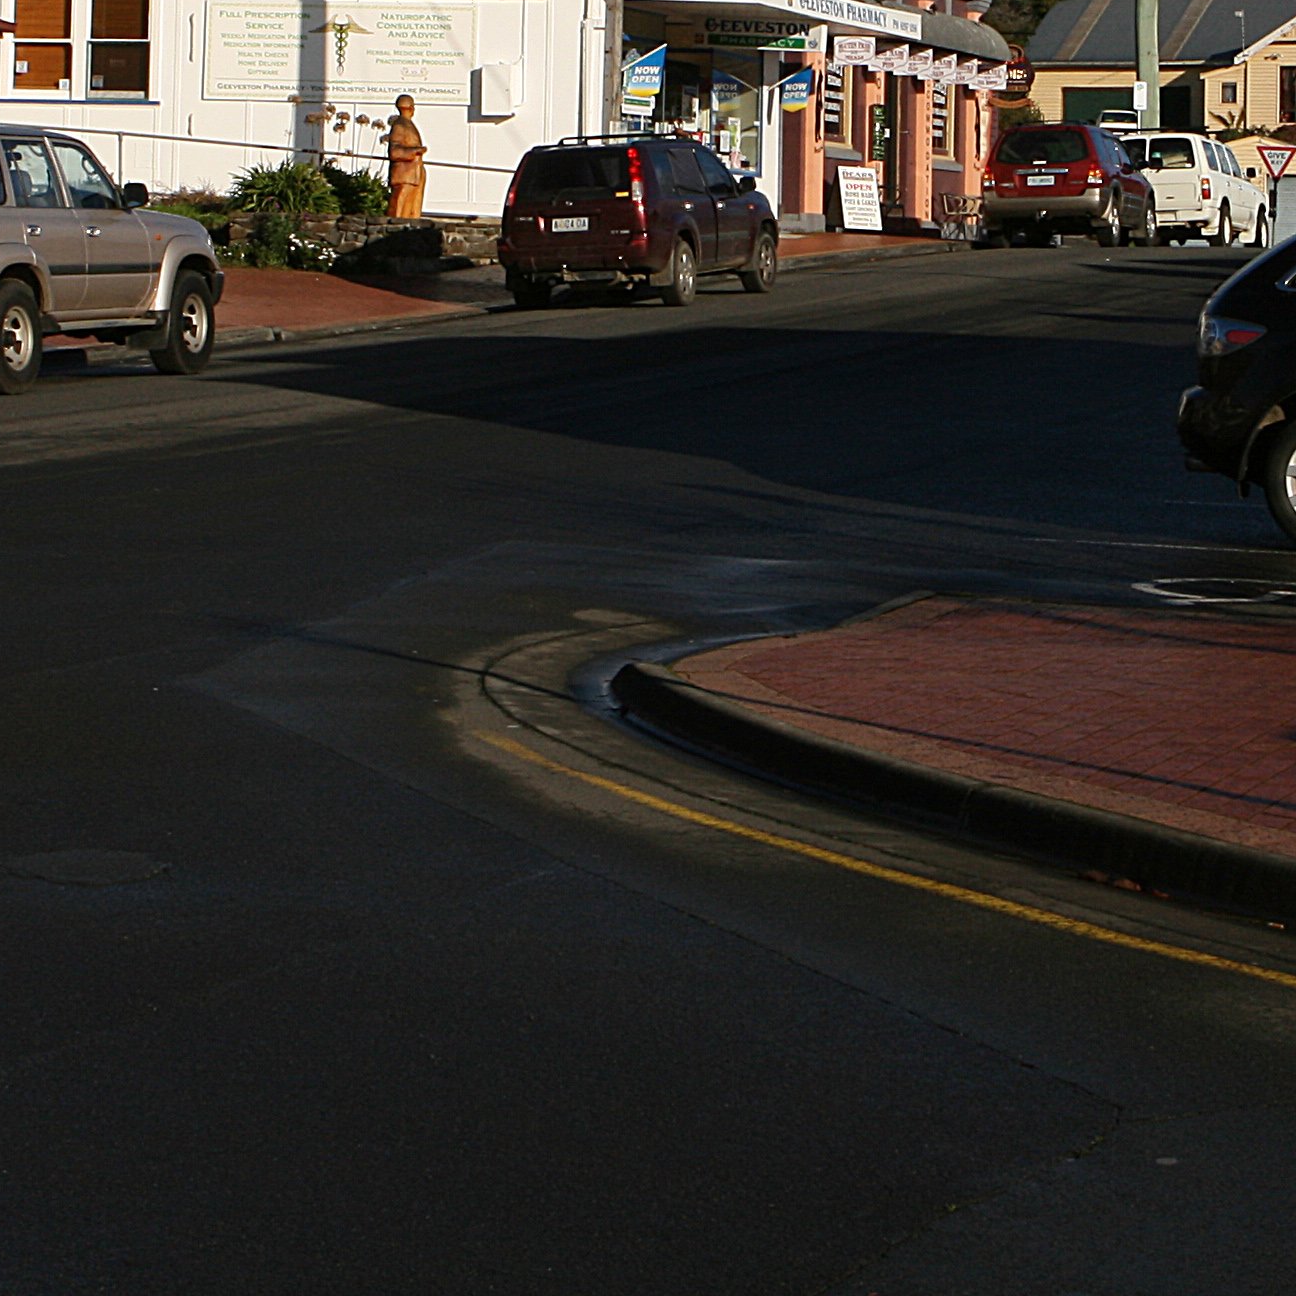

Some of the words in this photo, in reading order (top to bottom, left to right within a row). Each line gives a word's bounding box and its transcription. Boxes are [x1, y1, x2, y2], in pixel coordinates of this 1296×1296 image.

[219, 10, 242, 18] FULL
[244, 11, 310, 19] PRESCRIPTION
[381, 13, 452, 21] NATUROPATHIC
[846, 3, 888, 28] PHARMACY
[376, 21, 452, 30] CONSULTATIONS
[705, 18, 810, 36] GEEVESTON
[410, 31, 445, 39] ADVICE
[720, 37, 795, 48] PHARMACY
[634, 66, 660, 75] NOW
[631, 75, 660, 84] OPEN
[785, 83, 807, 91] NOW
[783, 91, 807, 99] OPEN
[1267, 152, 1287, 160] GIVE
[846, 183, 872, 191] OPEN
